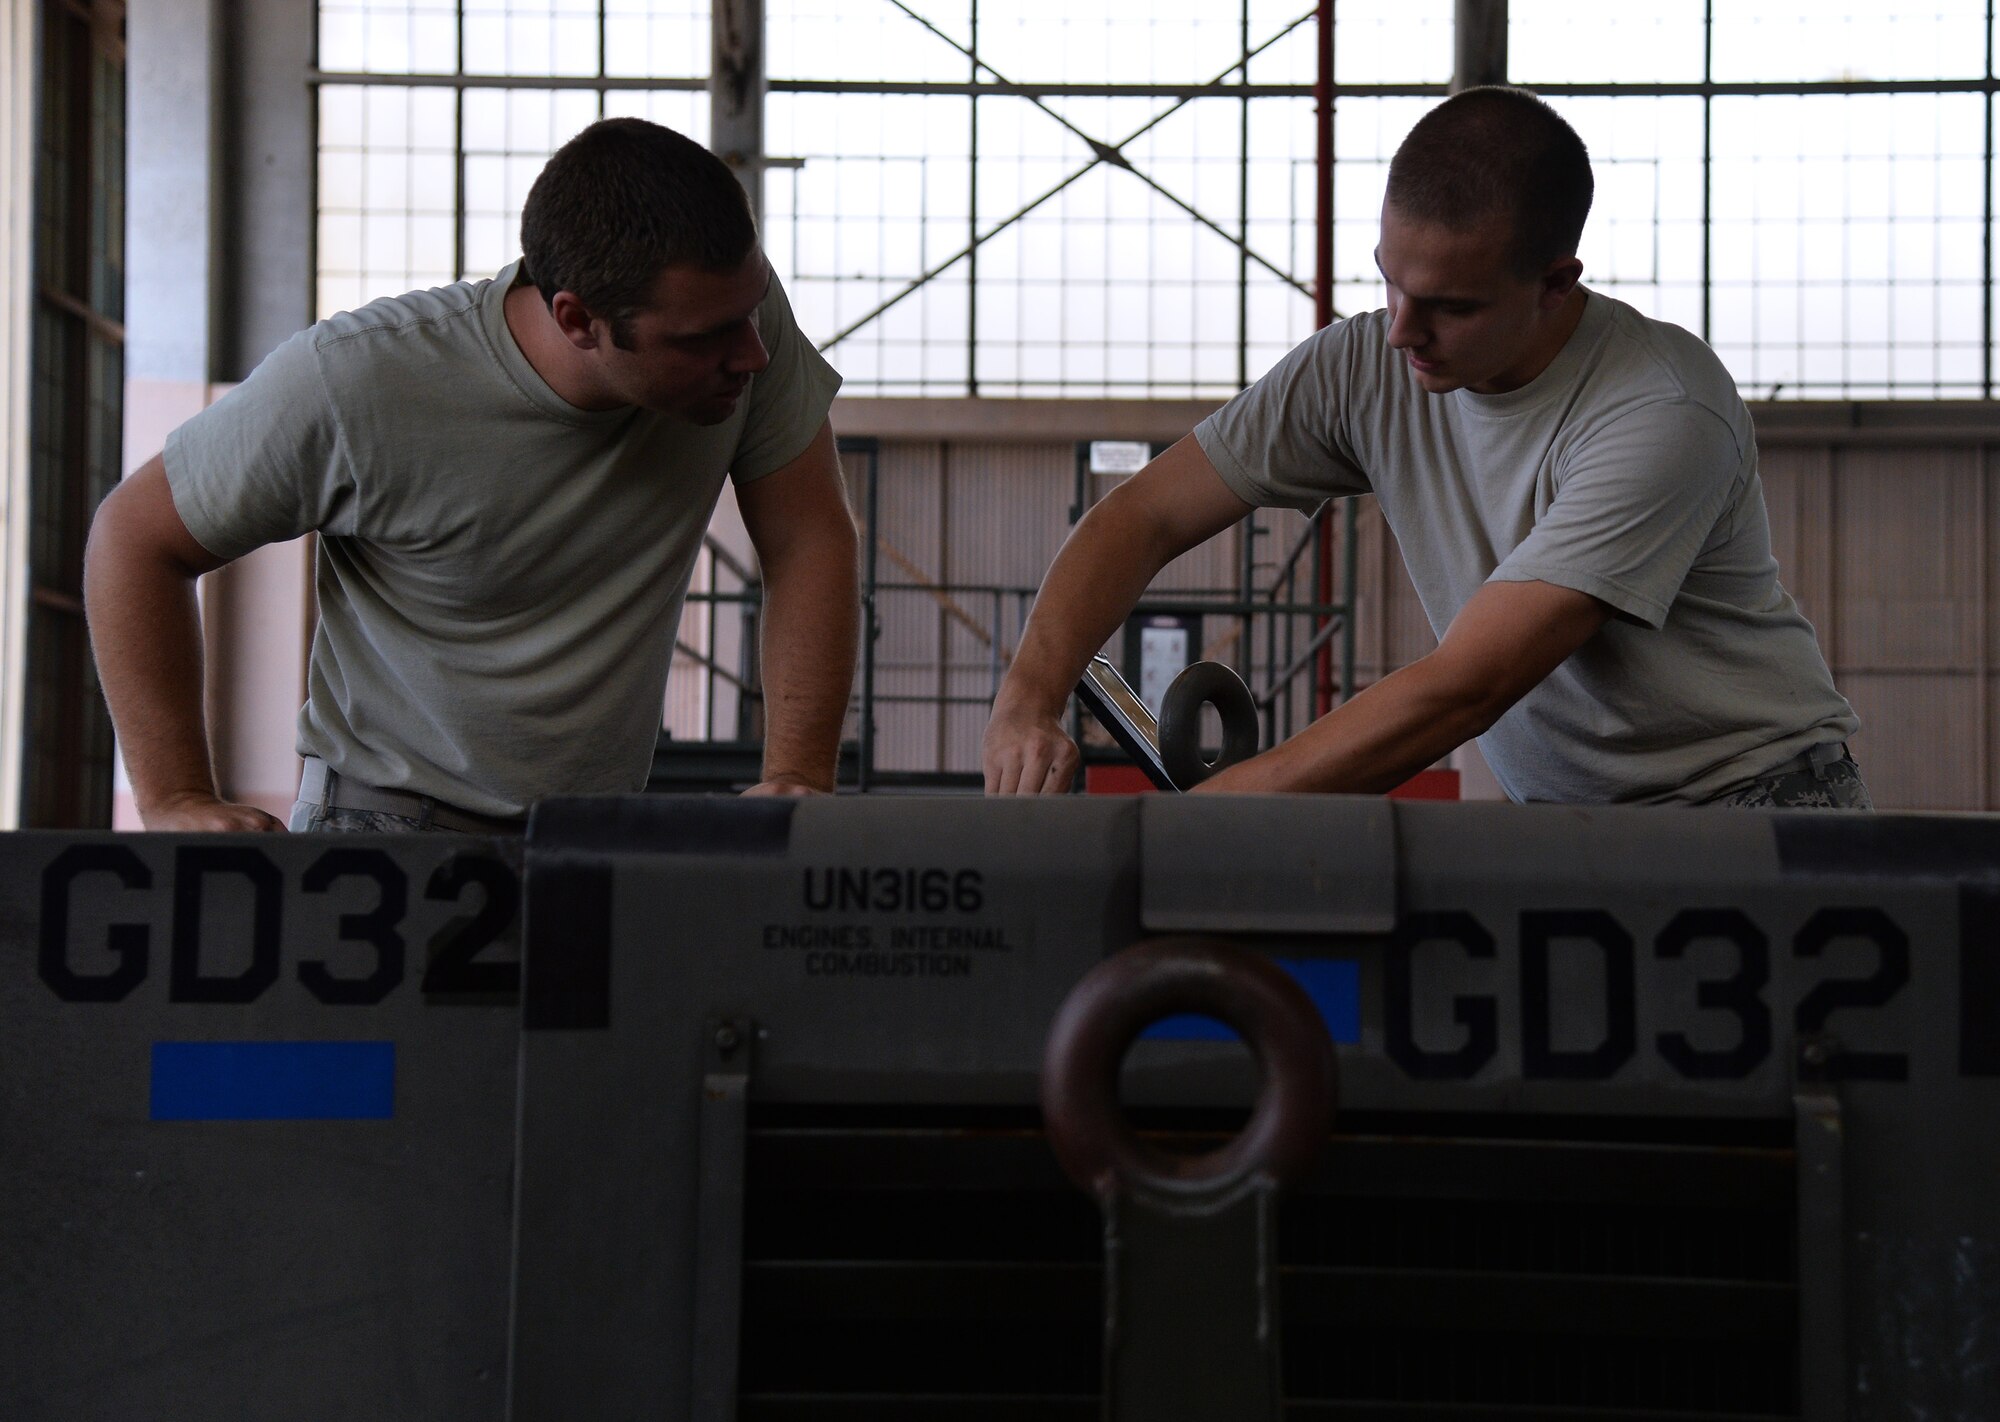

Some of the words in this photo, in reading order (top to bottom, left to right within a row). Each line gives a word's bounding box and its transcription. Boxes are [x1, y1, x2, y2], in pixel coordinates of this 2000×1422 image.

[803, 867, 982, 911] UN3166
[38, 844, 520, 1003] GD32
[891, 927, 1012, 952] INTERNAL
[805, 952, 972, 977] COMBUSTION
[1384, 908, 1909, 1081] GD32
